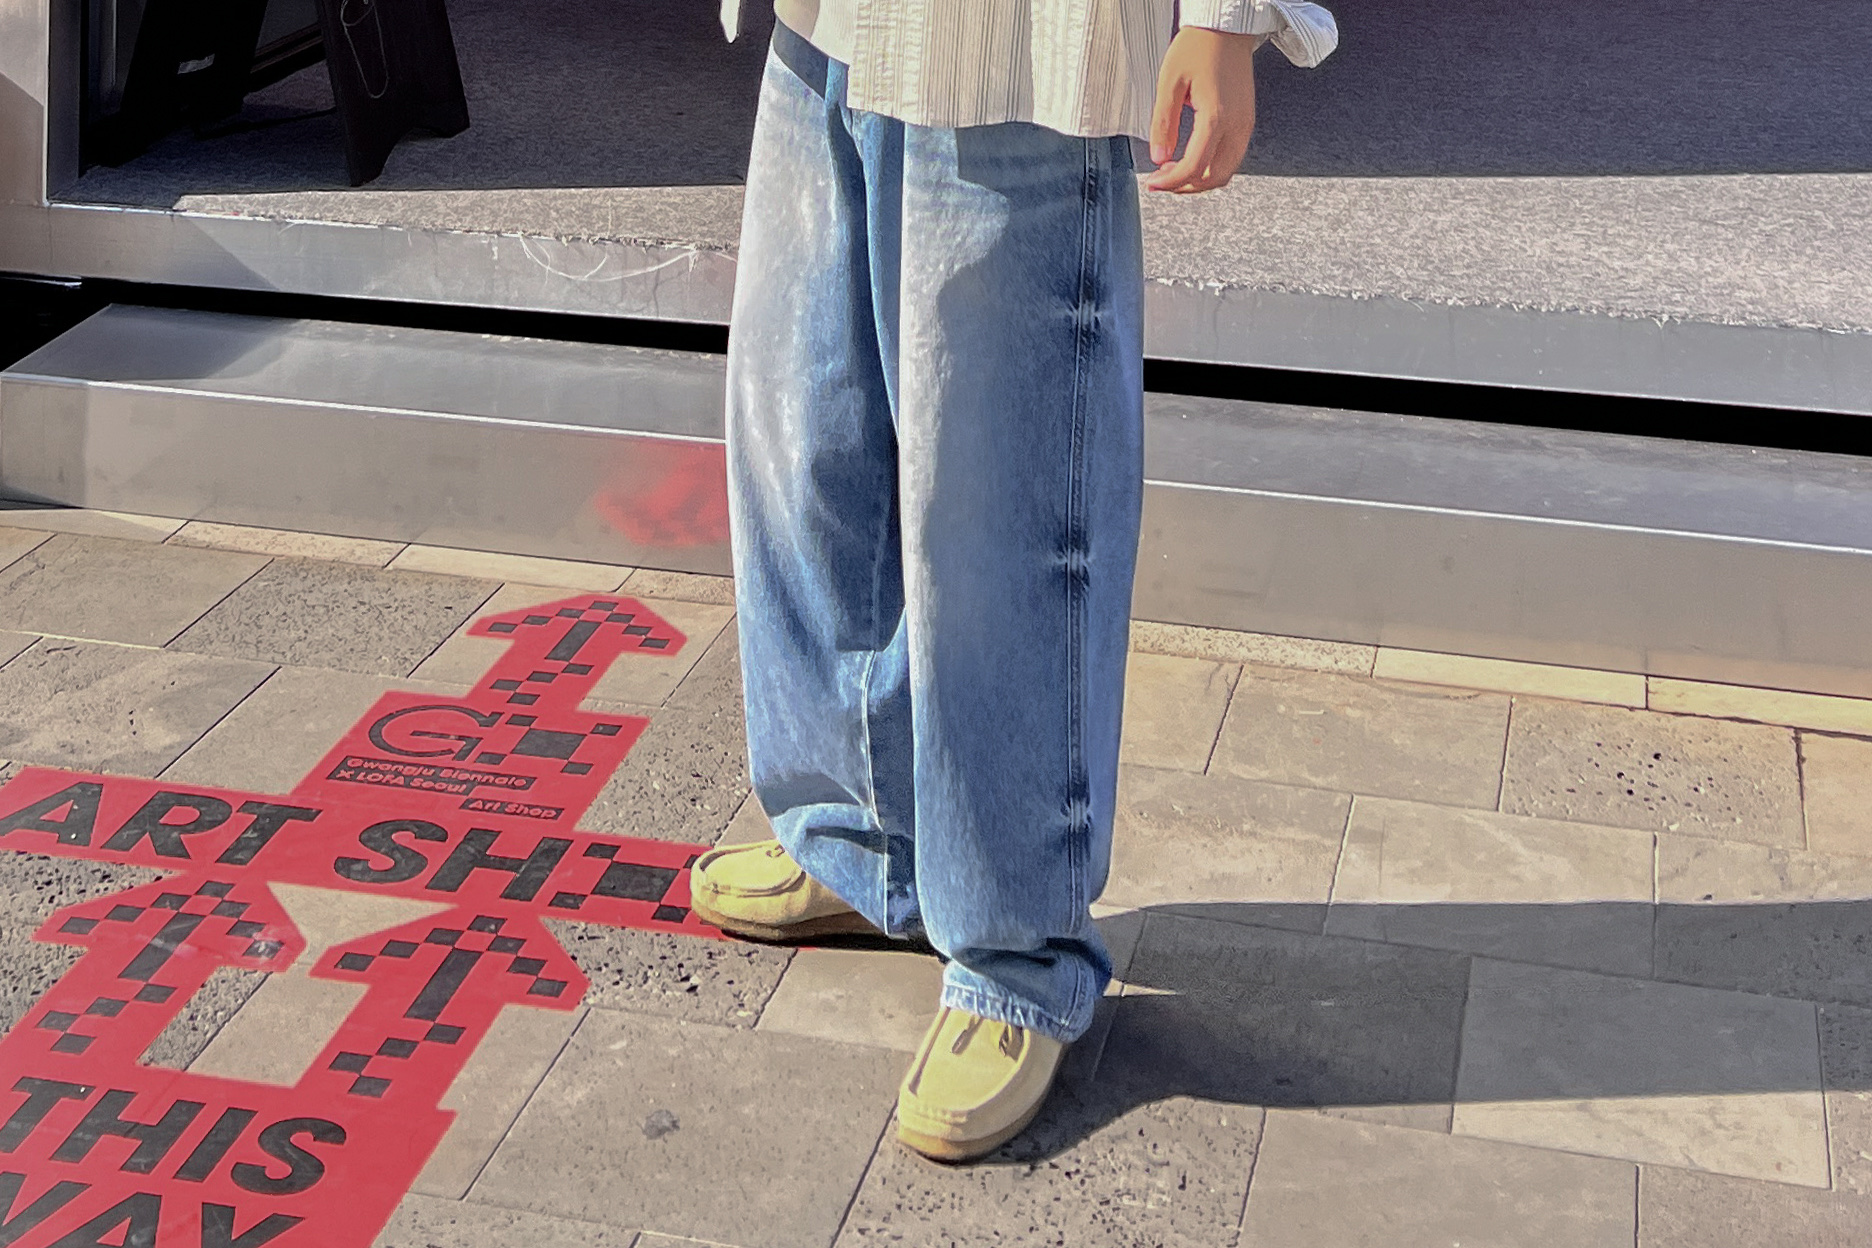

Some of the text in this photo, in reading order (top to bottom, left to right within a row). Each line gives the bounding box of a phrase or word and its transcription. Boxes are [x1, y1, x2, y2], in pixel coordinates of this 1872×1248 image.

[346, 758, 528, 788] Gwangju Biennale
[356, 771, 405, 786] LOFA
[409, 778, 467, 794] Seoul
[0, 781, 324, 865] ART
[468, 799, 558, 819] Art Shop
[0, 1076, 347, 1196] THIS
